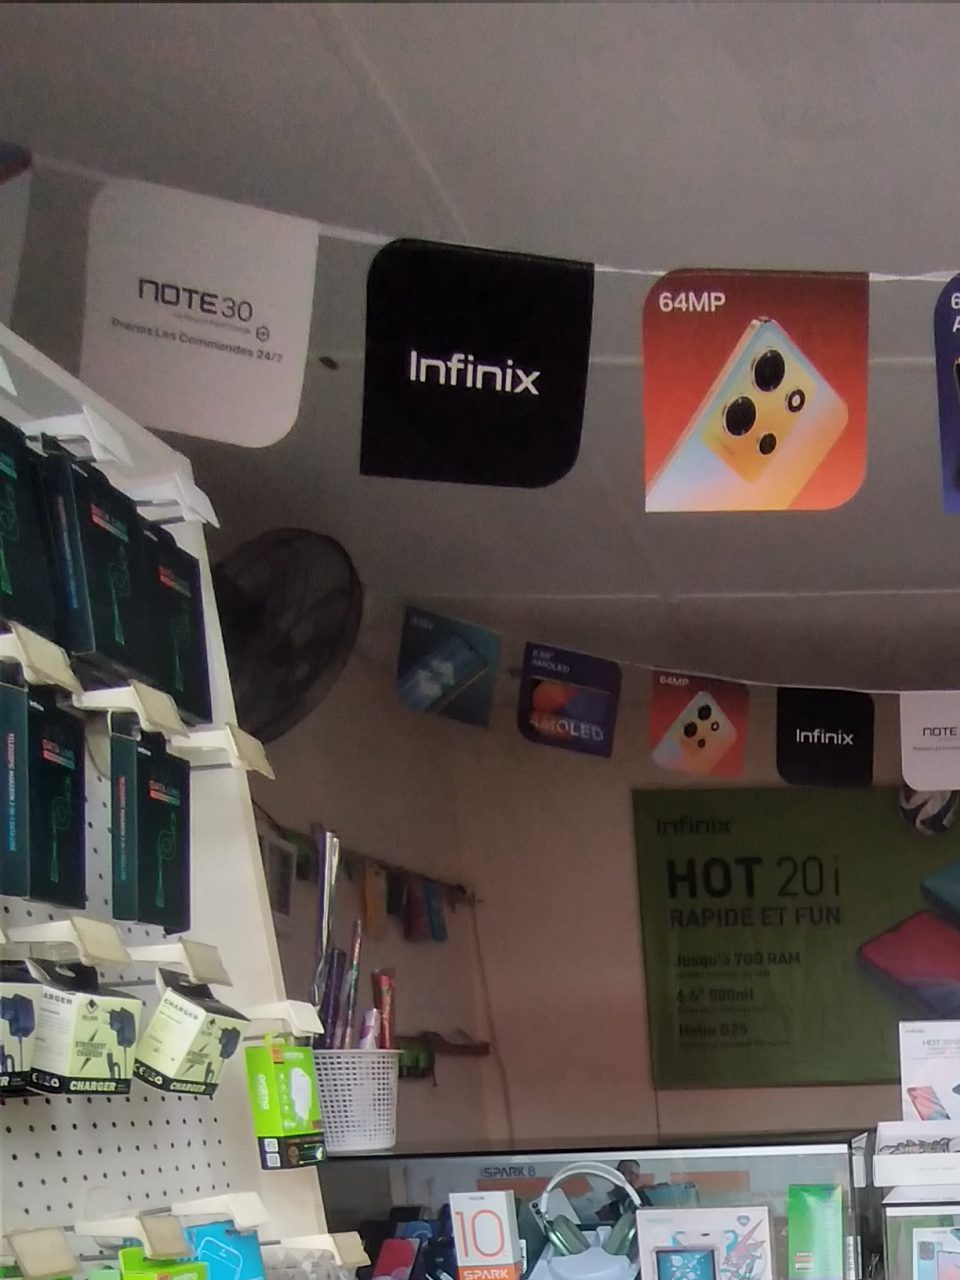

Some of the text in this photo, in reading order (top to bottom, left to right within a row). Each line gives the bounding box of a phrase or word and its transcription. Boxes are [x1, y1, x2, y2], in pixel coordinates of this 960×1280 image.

[658, 291, 727, 313] 64MP
[179, 331, 254, 358] Commandes
[256, 350, 284, 363] 24/7
[409, 350, 540, 396] Infinix
[530, 659, 572, 675] AMOLED
[658, 675, 691, 687] 64MP
[529, 714, 604, 741] AMOLED
[796, 729, 854, 747] Infinix
[656, 816, 732, 835] Infinix
[666, 856, 763, 899] HOT
[669, 906, 841, 928] RAPIDE ET FUN
[767, 951, 801, 966] RAM
[44, 992, 73, 1007] ARGER
[163, 998, 200, 1021] CHARGER
[69, 1080, 118, 1093] CHARGER
[484, 1166, 537, 1182] SPARK 8
